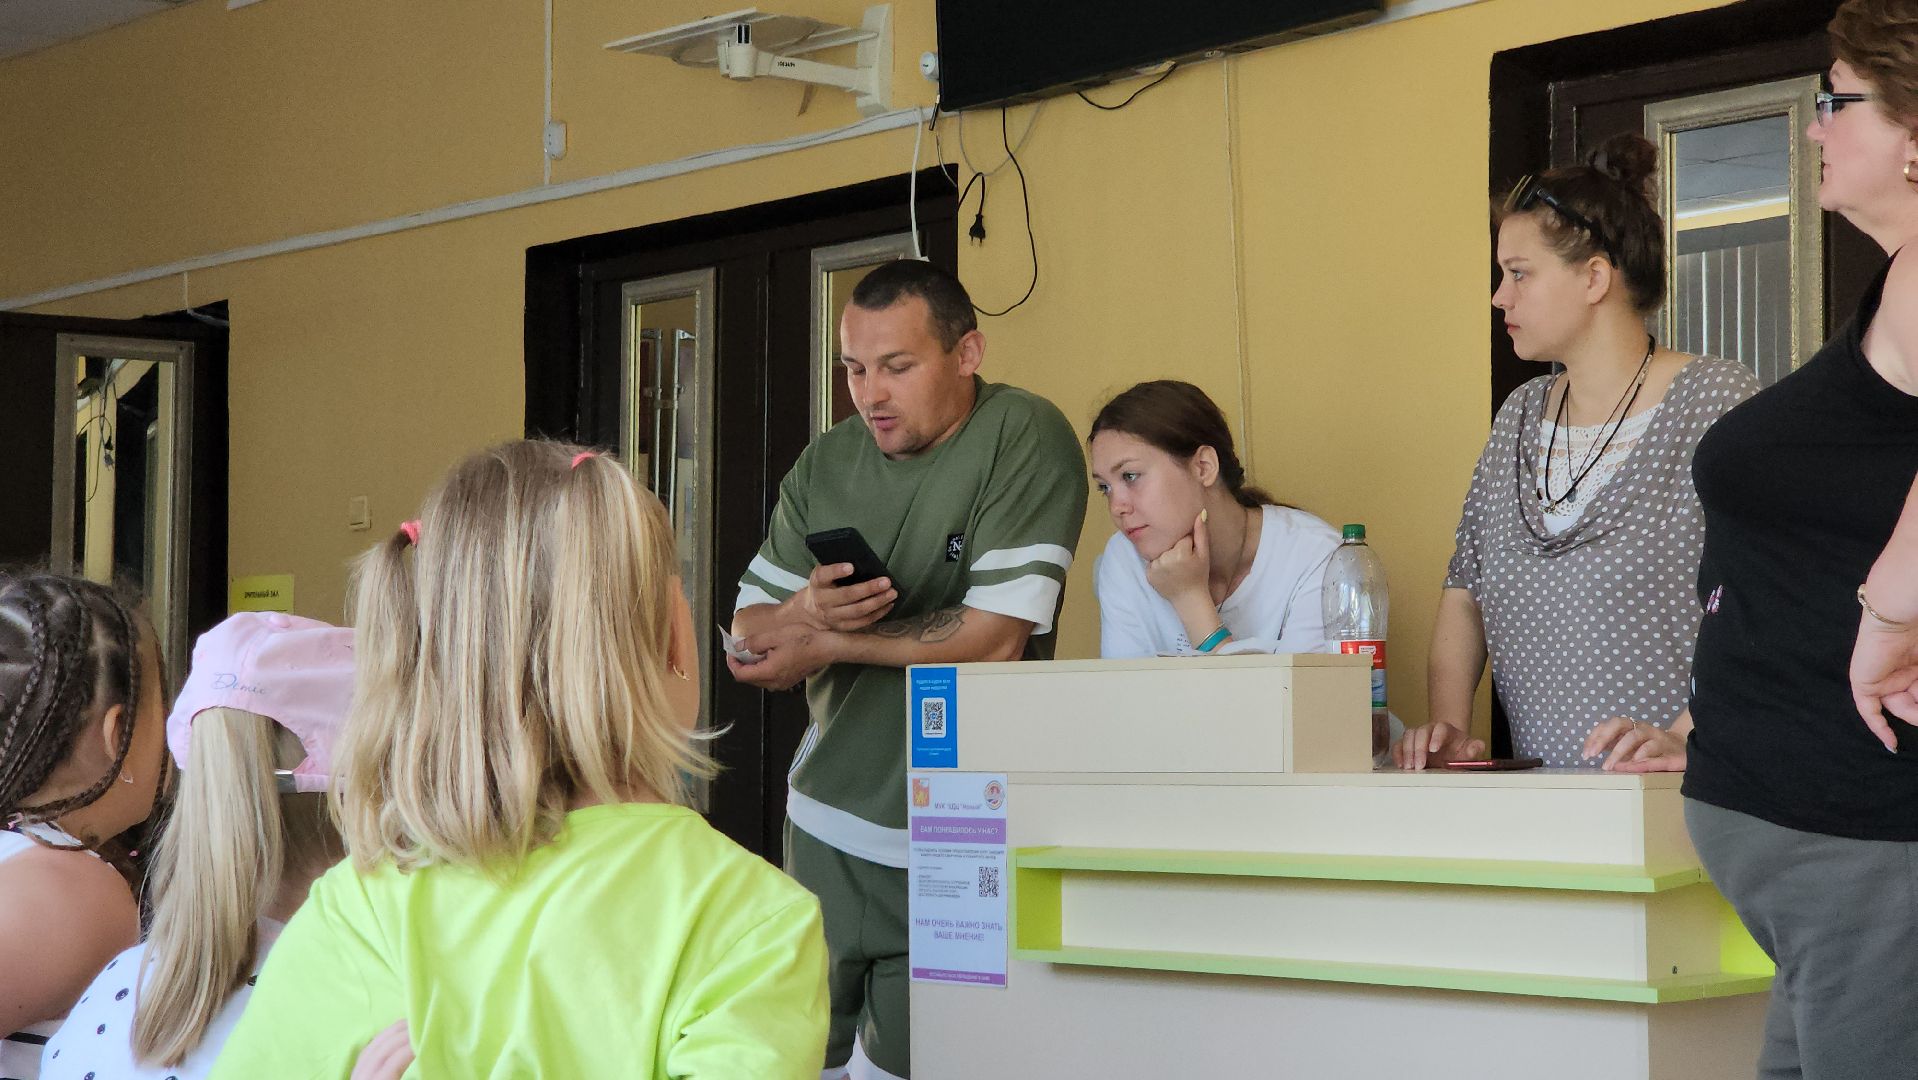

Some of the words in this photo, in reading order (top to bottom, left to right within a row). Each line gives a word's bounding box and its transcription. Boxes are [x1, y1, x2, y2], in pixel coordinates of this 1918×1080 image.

[920, 825, 933, 833] ВАМ
[915, 918, 930, 927] НАМ
[931, 919, 955, 928] ОЧЕНЬ
[955, 921, 980, 930] ВАЖНО
[981, 922, 1003, 932] ЗНАТЬ
[934, 931, 953, 940] ВАШЕ
